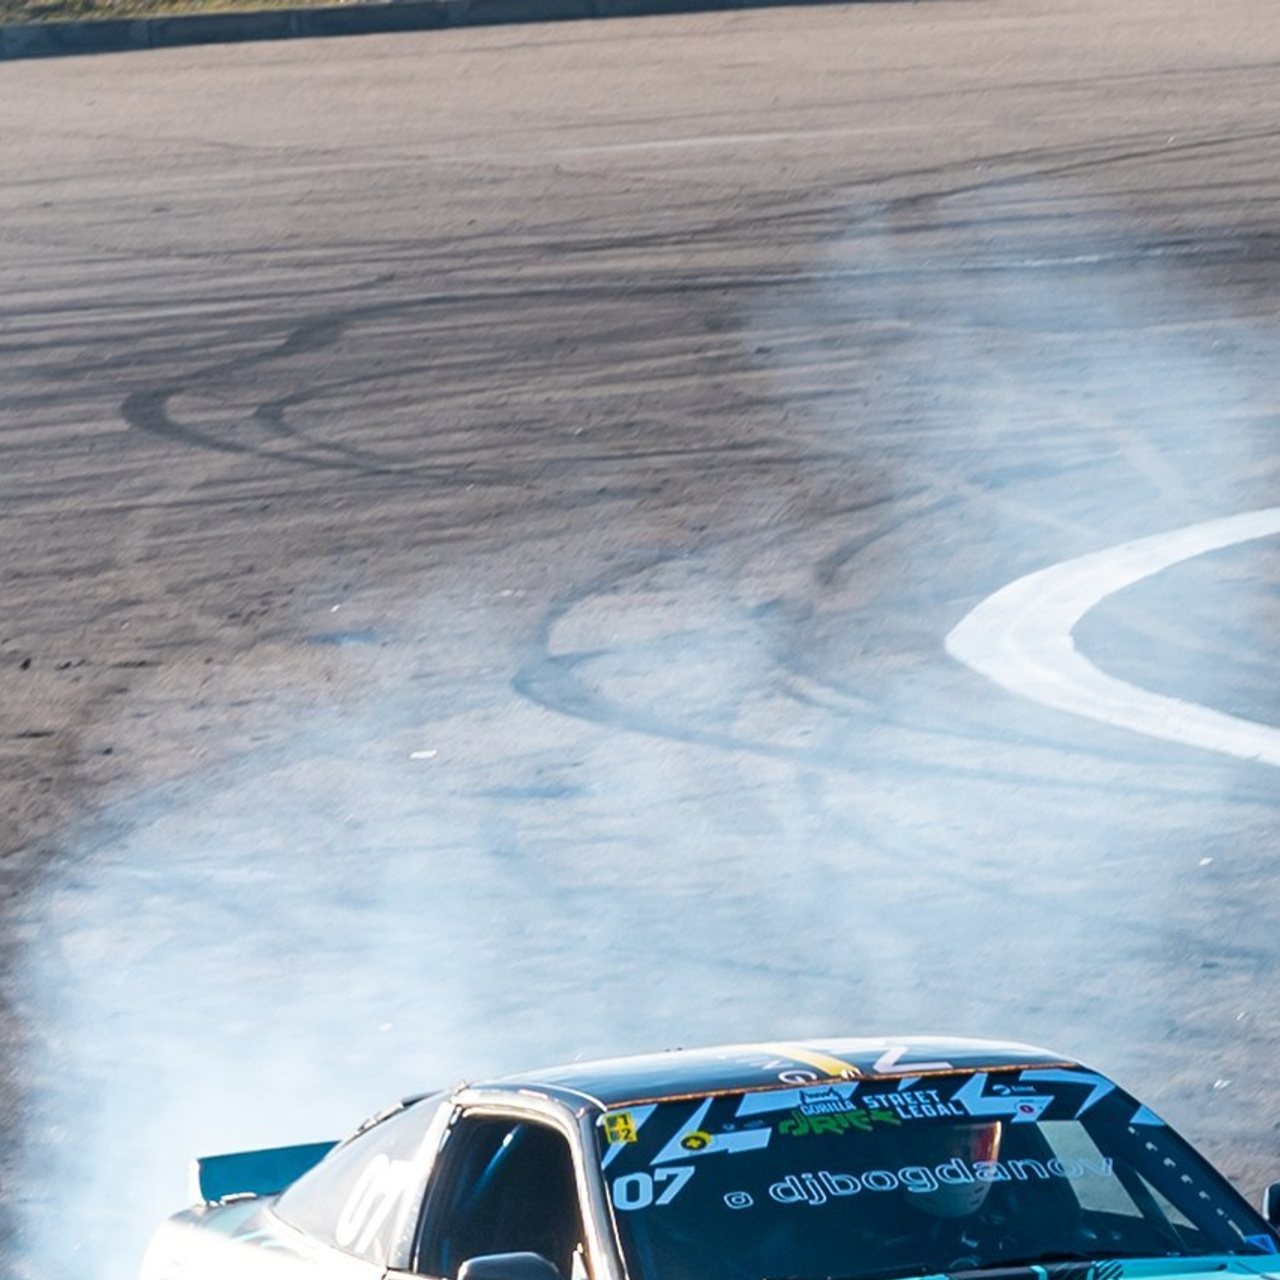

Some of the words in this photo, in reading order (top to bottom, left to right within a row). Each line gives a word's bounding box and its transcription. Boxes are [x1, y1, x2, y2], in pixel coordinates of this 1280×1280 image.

[862, 1089, 941, 1108] STREET
[799, 1100, 858, 1117] GORILLA
[895, 1102, 965, 1119] LEGAL
[612, 1165, 695, 1211] 07
[768, 1156, 1113, 1206] djbogdanov
